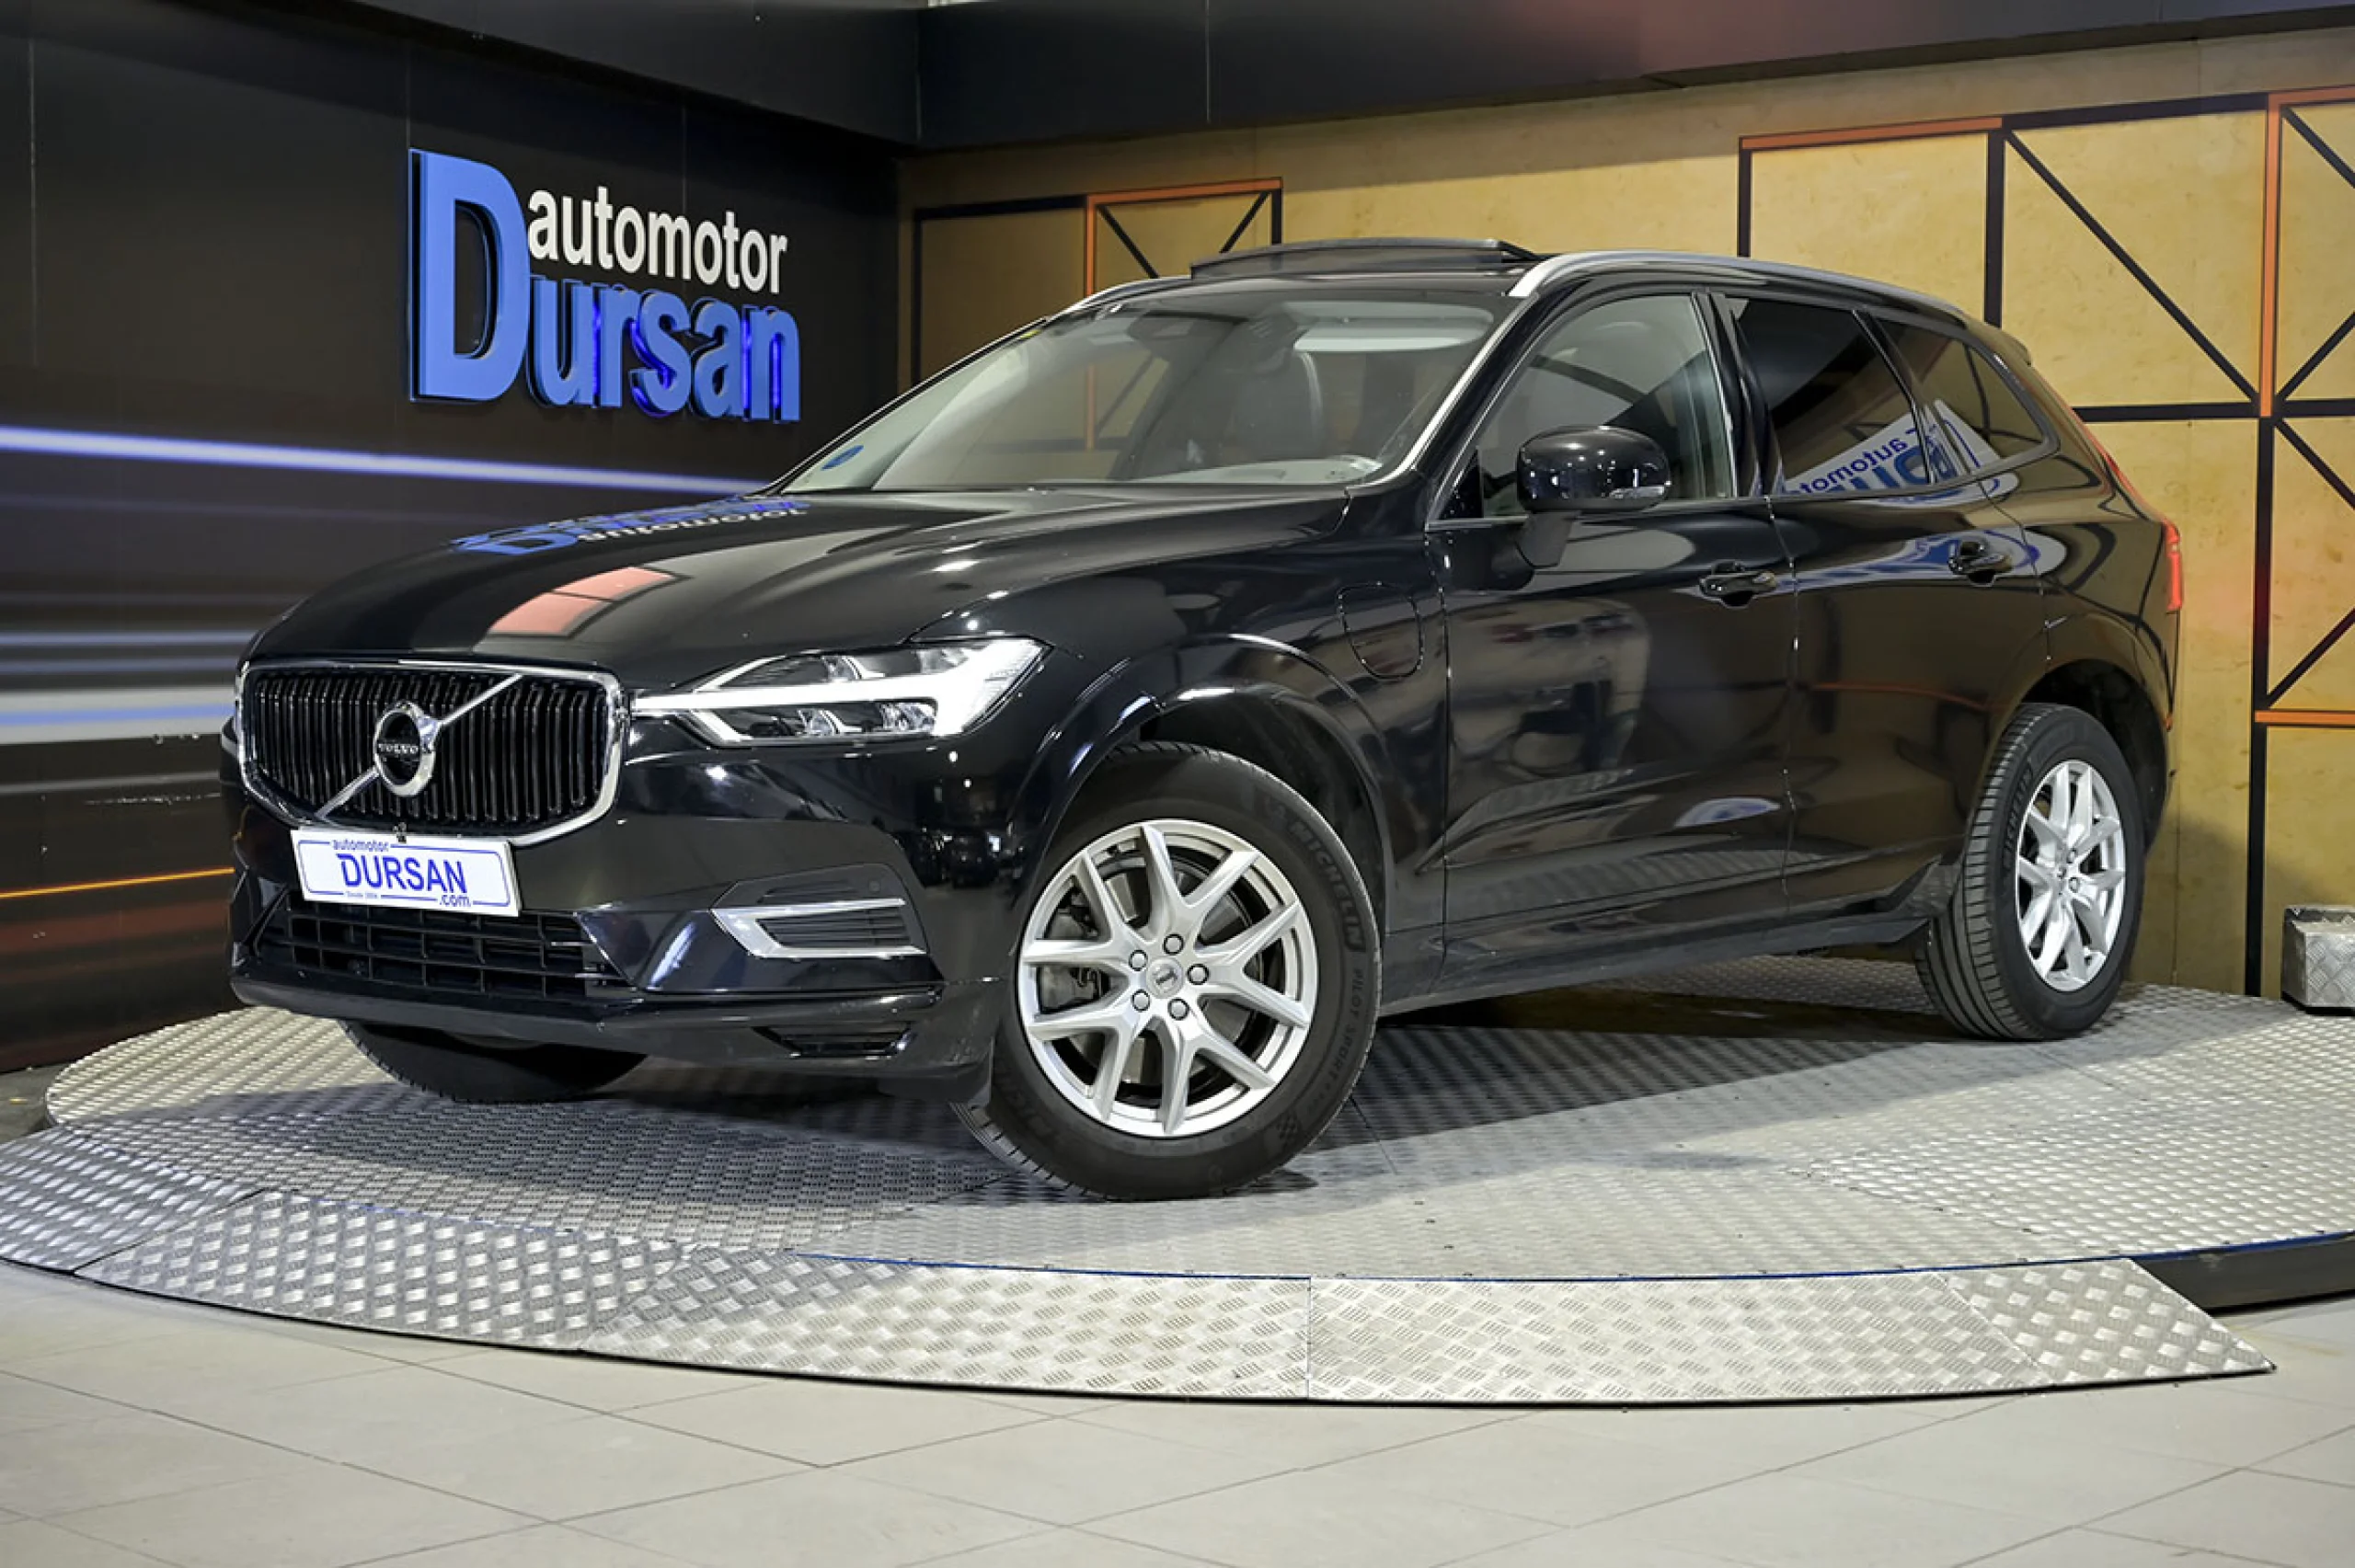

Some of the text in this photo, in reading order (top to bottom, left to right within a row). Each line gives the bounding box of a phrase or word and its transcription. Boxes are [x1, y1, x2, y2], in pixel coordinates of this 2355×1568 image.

[528, 186, 787, 294] automotor
[409, 148, 801, 423] Dursan
[377, 742, 419, 754] VOLVO
[336, 853, 467, 894] DURSAN
